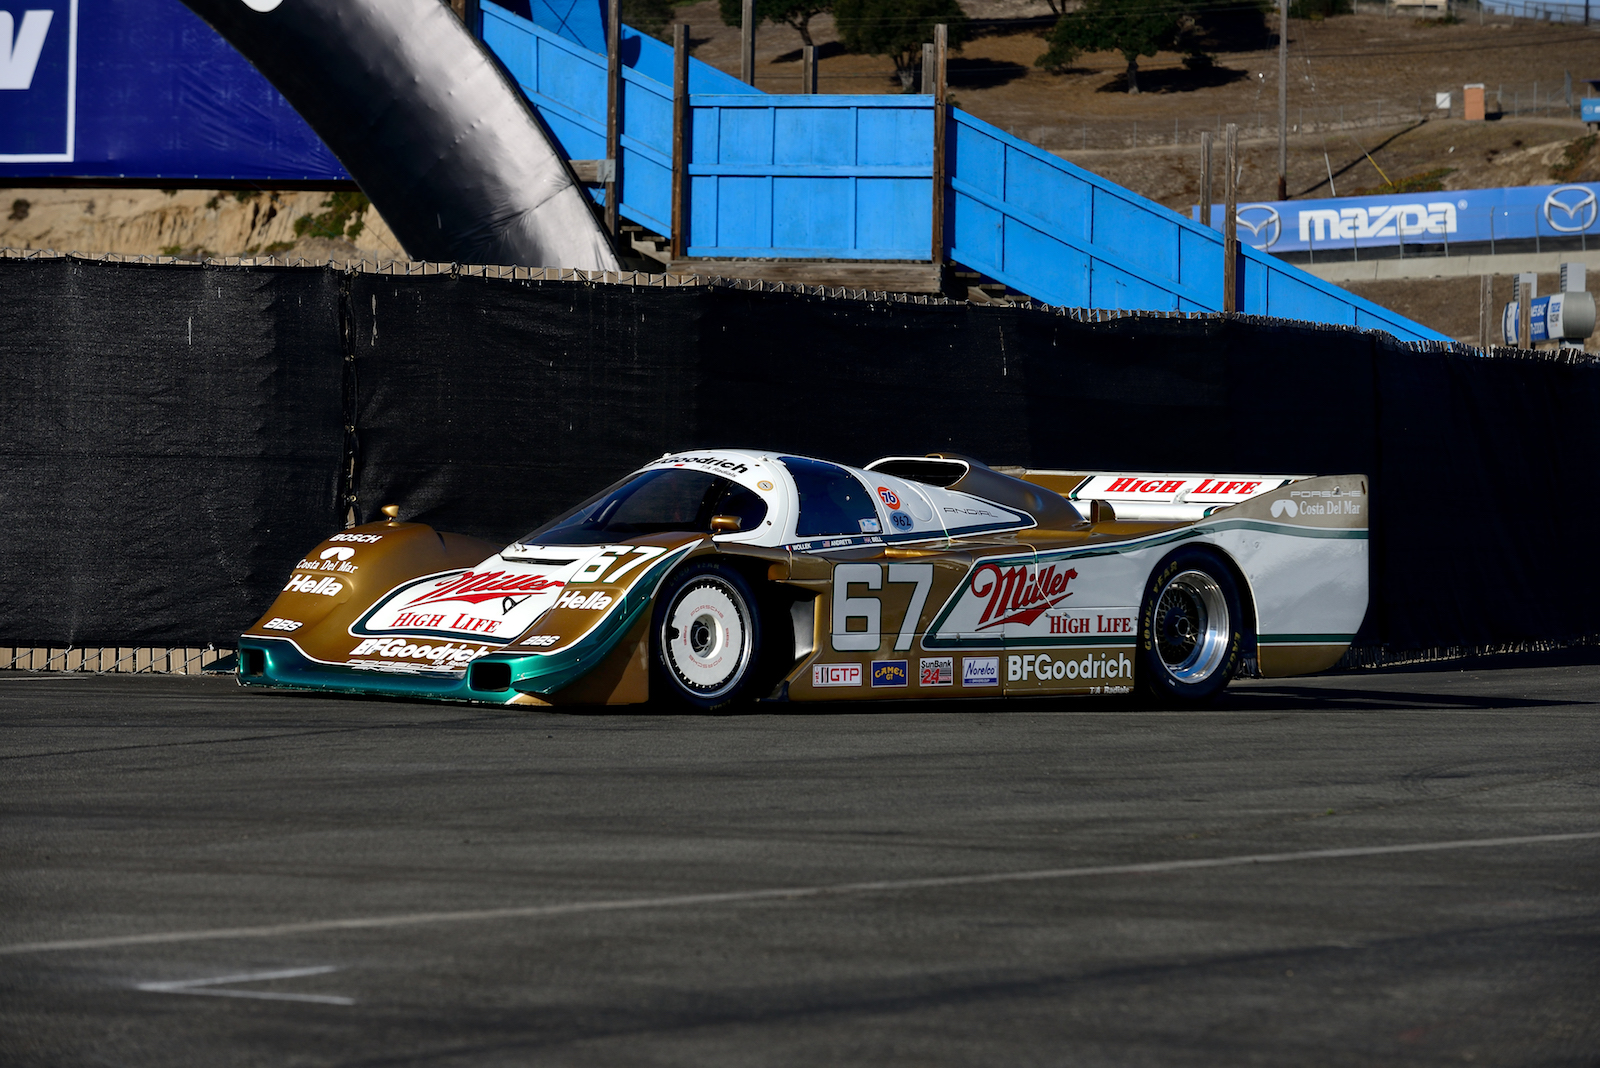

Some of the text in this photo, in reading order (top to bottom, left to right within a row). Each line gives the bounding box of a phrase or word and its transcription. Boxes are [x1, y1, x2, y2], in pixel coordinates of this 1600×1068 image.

[1299, 202, 1457, 242] mazda
[712, 467, 737, 478] Radials
[1104, 477, 1262, 495] HIGH LIFE
[1290, 490, 1361, 498] PORSCHE
[881, 491, 896, 503] 76
[943, 507, 998, 518] ANDIAL
[1300, 500, 1360, 515] Costa Del Mar
[893, 515, 911, 527] 962
[329, 533, 383, 543] BOSCH
[831, 538, 853, 547] ANDRETTI
[296, 558, 358, 574] Costa Del Mar
[569, 545, 669, 584] 67
[283, 574, 343, 597] Hella
[404, 570, 565, 606] Miller
[551, 590, 613, 610] Hella
[971, 563, 1078, 625] Miller
[831, 562, 934, 652] 67
[262, 617, 304, 632] BBS
[389, 611, 502, 634] HIGH LIFE
[1049, 615, 1131, 634] HIGH LIFE
[519, 635, 561, 647] BBS
[349, 638, 490, 661] BFGoodrich
[921, 659, 951, 669] SunBank
[965, 660, 995, 677] Norelco
[1007, 652, 1132, 681] BFGoodrich
[830, 668, 859, 682] GTP
[875, 666, 904, 679] CAMEL
[886, 673, 893, 681] GT
[922, 668, 940, 684] 24
